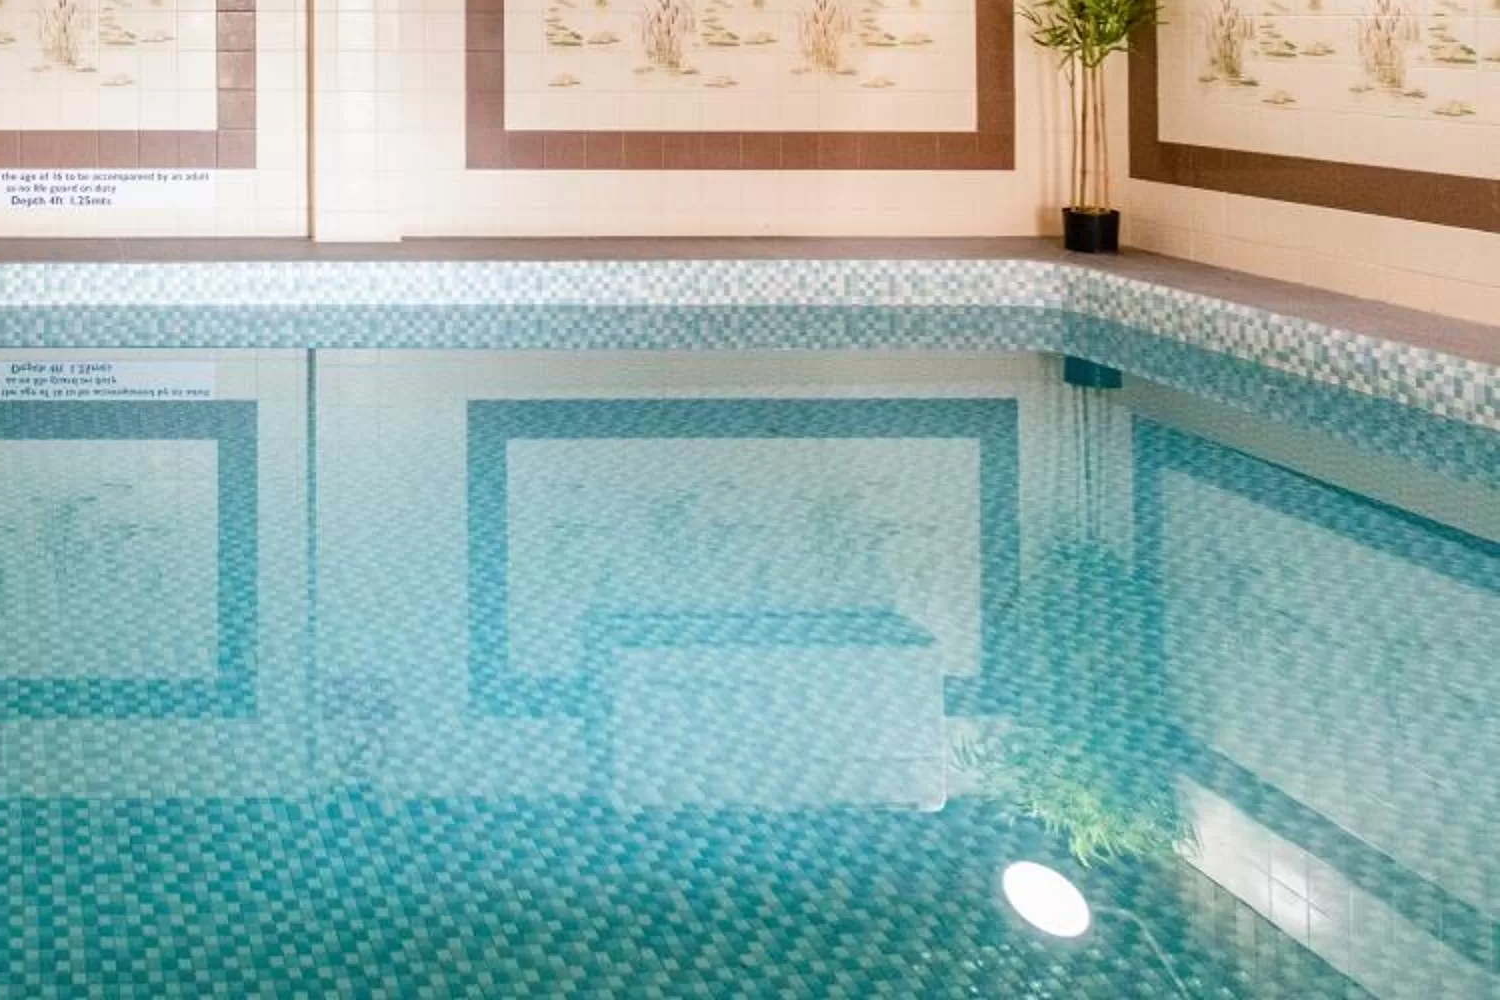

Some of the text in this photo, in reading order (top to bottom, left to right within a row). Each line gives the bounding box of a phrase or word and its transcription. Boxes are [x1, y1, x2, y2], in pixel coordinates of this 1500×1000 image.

[1, 172, 17, 181] the
[19, 174, 36, 183] age
[39, 172, 49, 181] of
[11, 195, 46, 207] Depth
